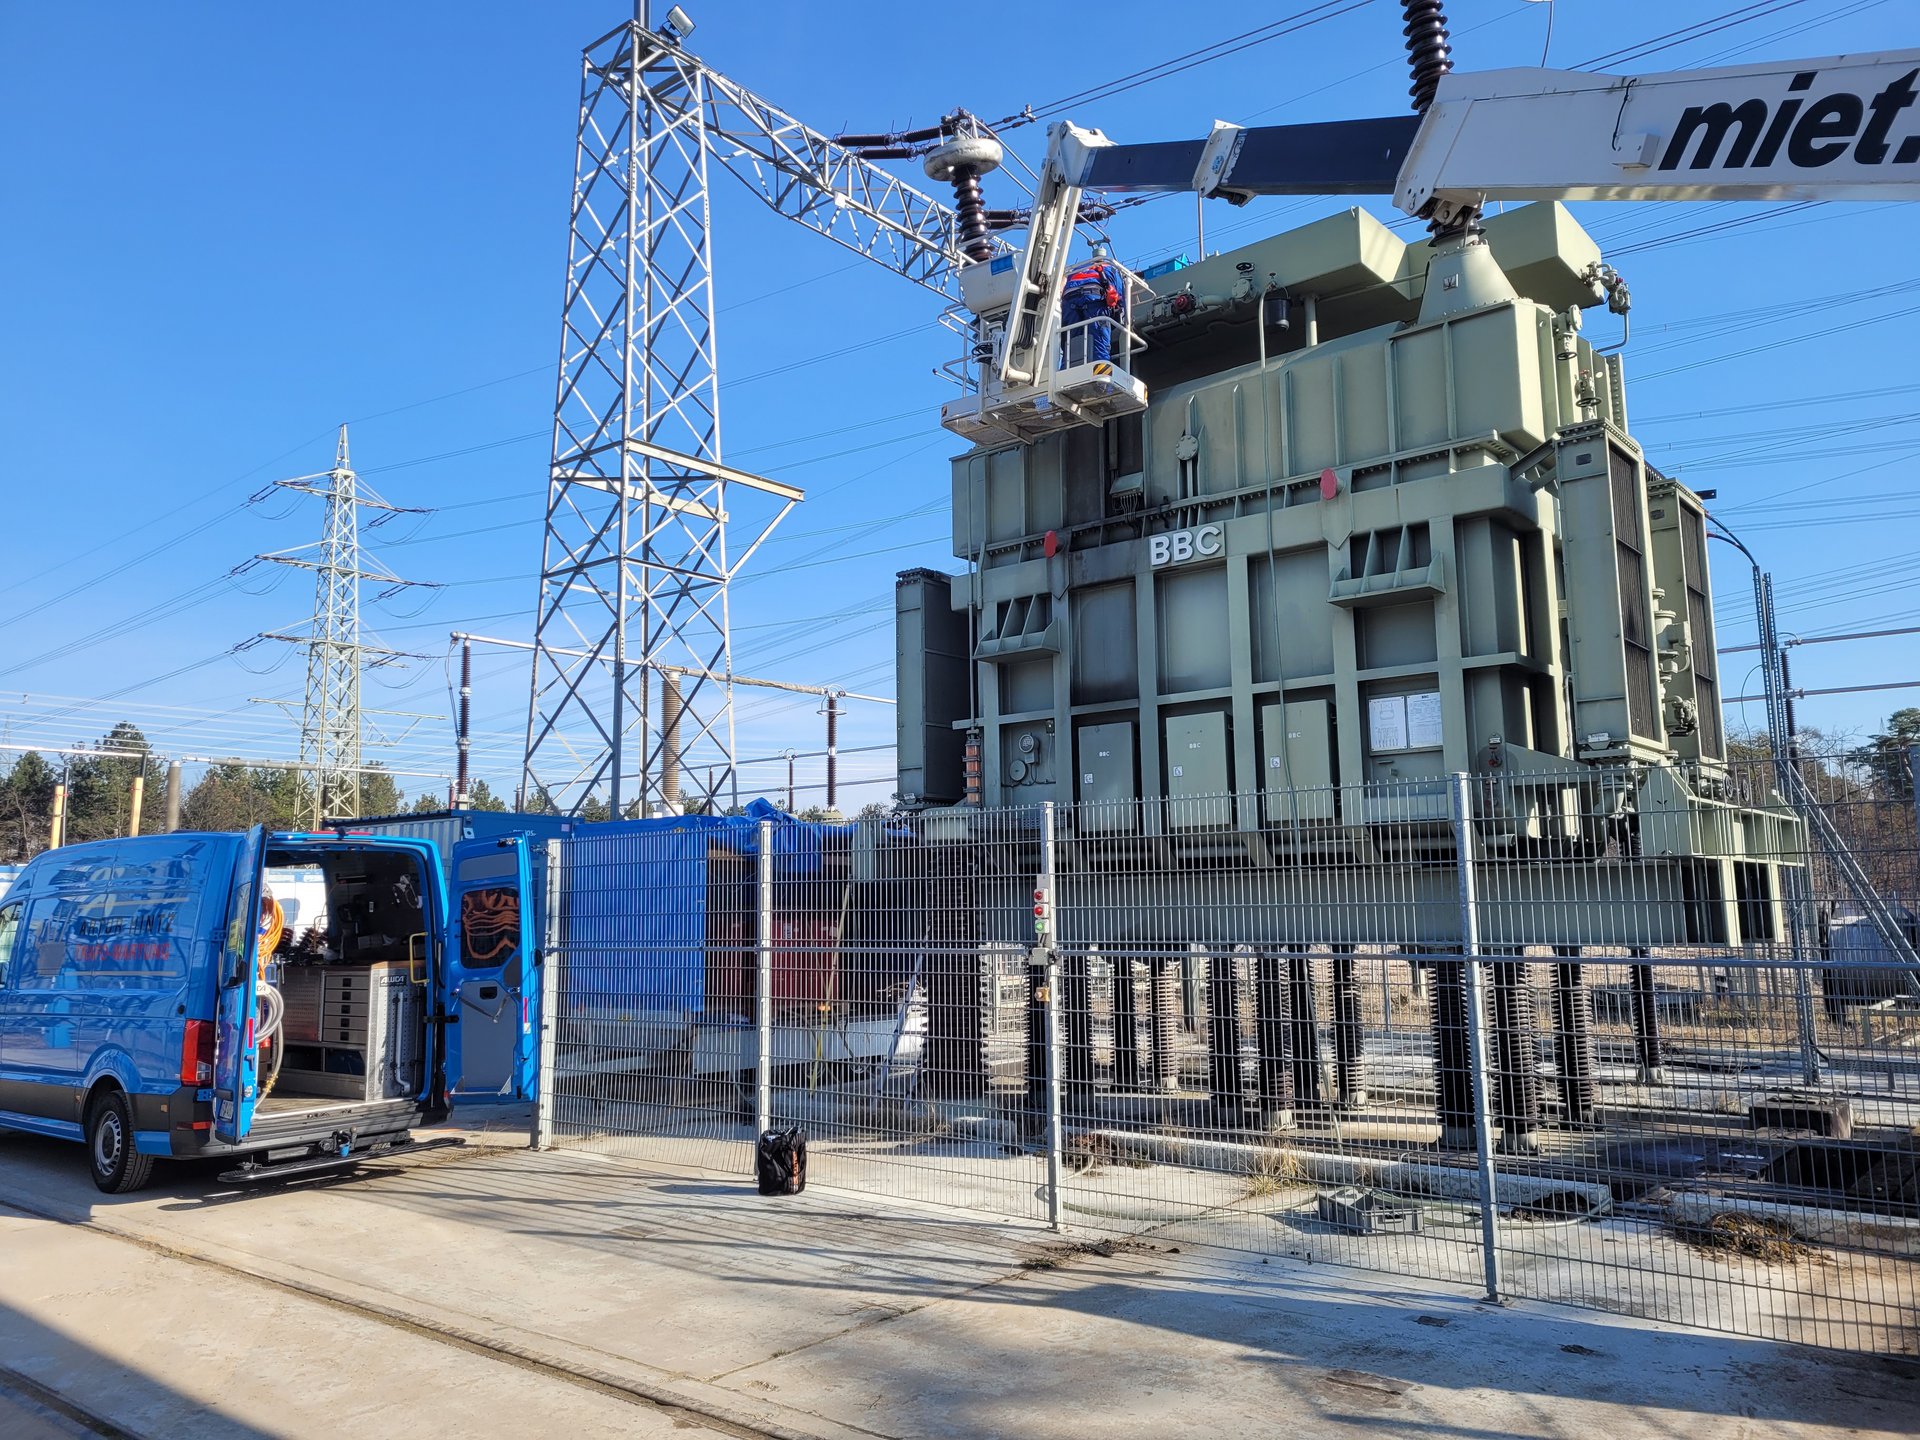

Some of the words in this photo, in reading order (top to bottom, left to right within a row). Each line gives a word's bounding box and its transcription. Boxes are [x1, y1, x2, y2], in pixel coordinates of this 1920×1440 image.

[1150, 526, 1221, 566] BBC
[80, 917, 123, 936] ARTUR
[128, 912, 175, 935] HINTZ
[380, 975, 405, 984] ALUCA
